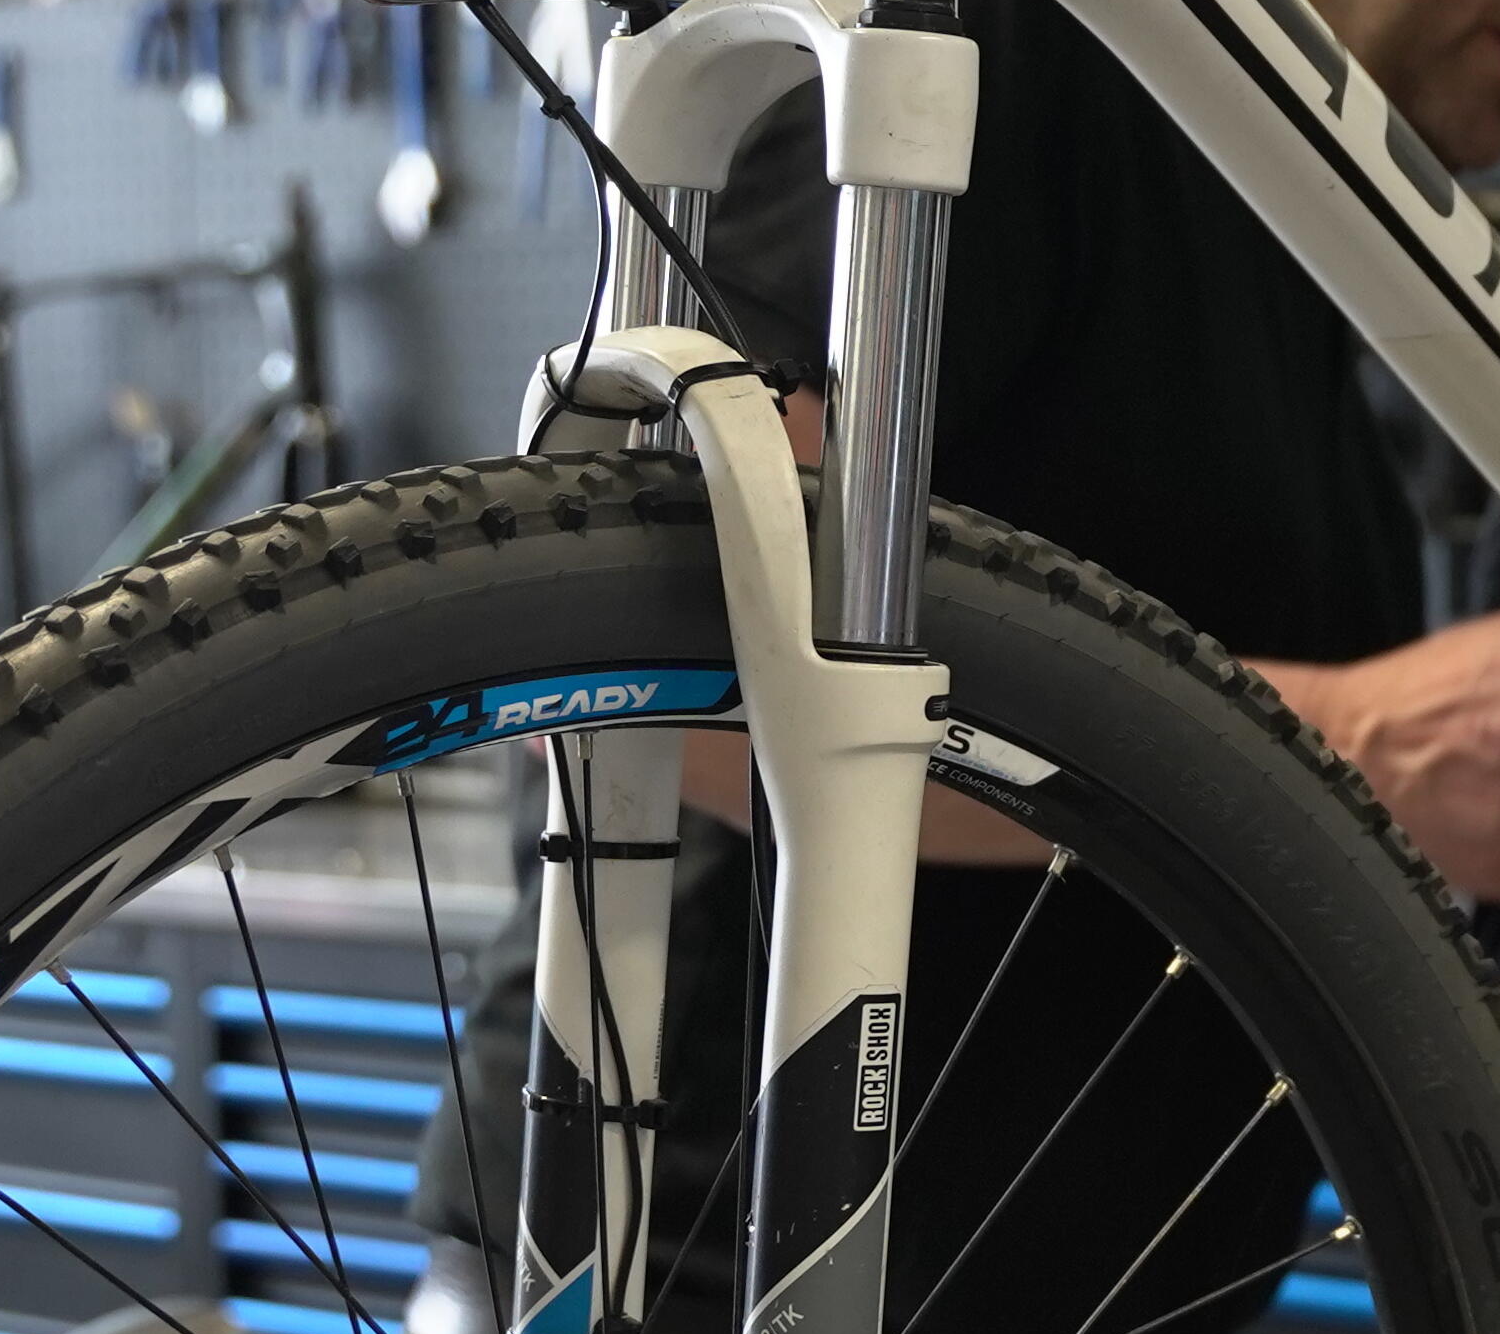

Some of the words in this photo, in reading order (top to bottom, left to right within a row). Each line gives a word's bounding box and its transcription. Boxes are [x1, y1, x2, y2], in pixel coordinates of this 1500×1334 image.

[493, 681, 661, 731] READY
[949, 769, 1036, 816] COMPONENTS
[866, 1007, 892, 1062] SHOX
[860, 1068, 888, 1124] ROCK
